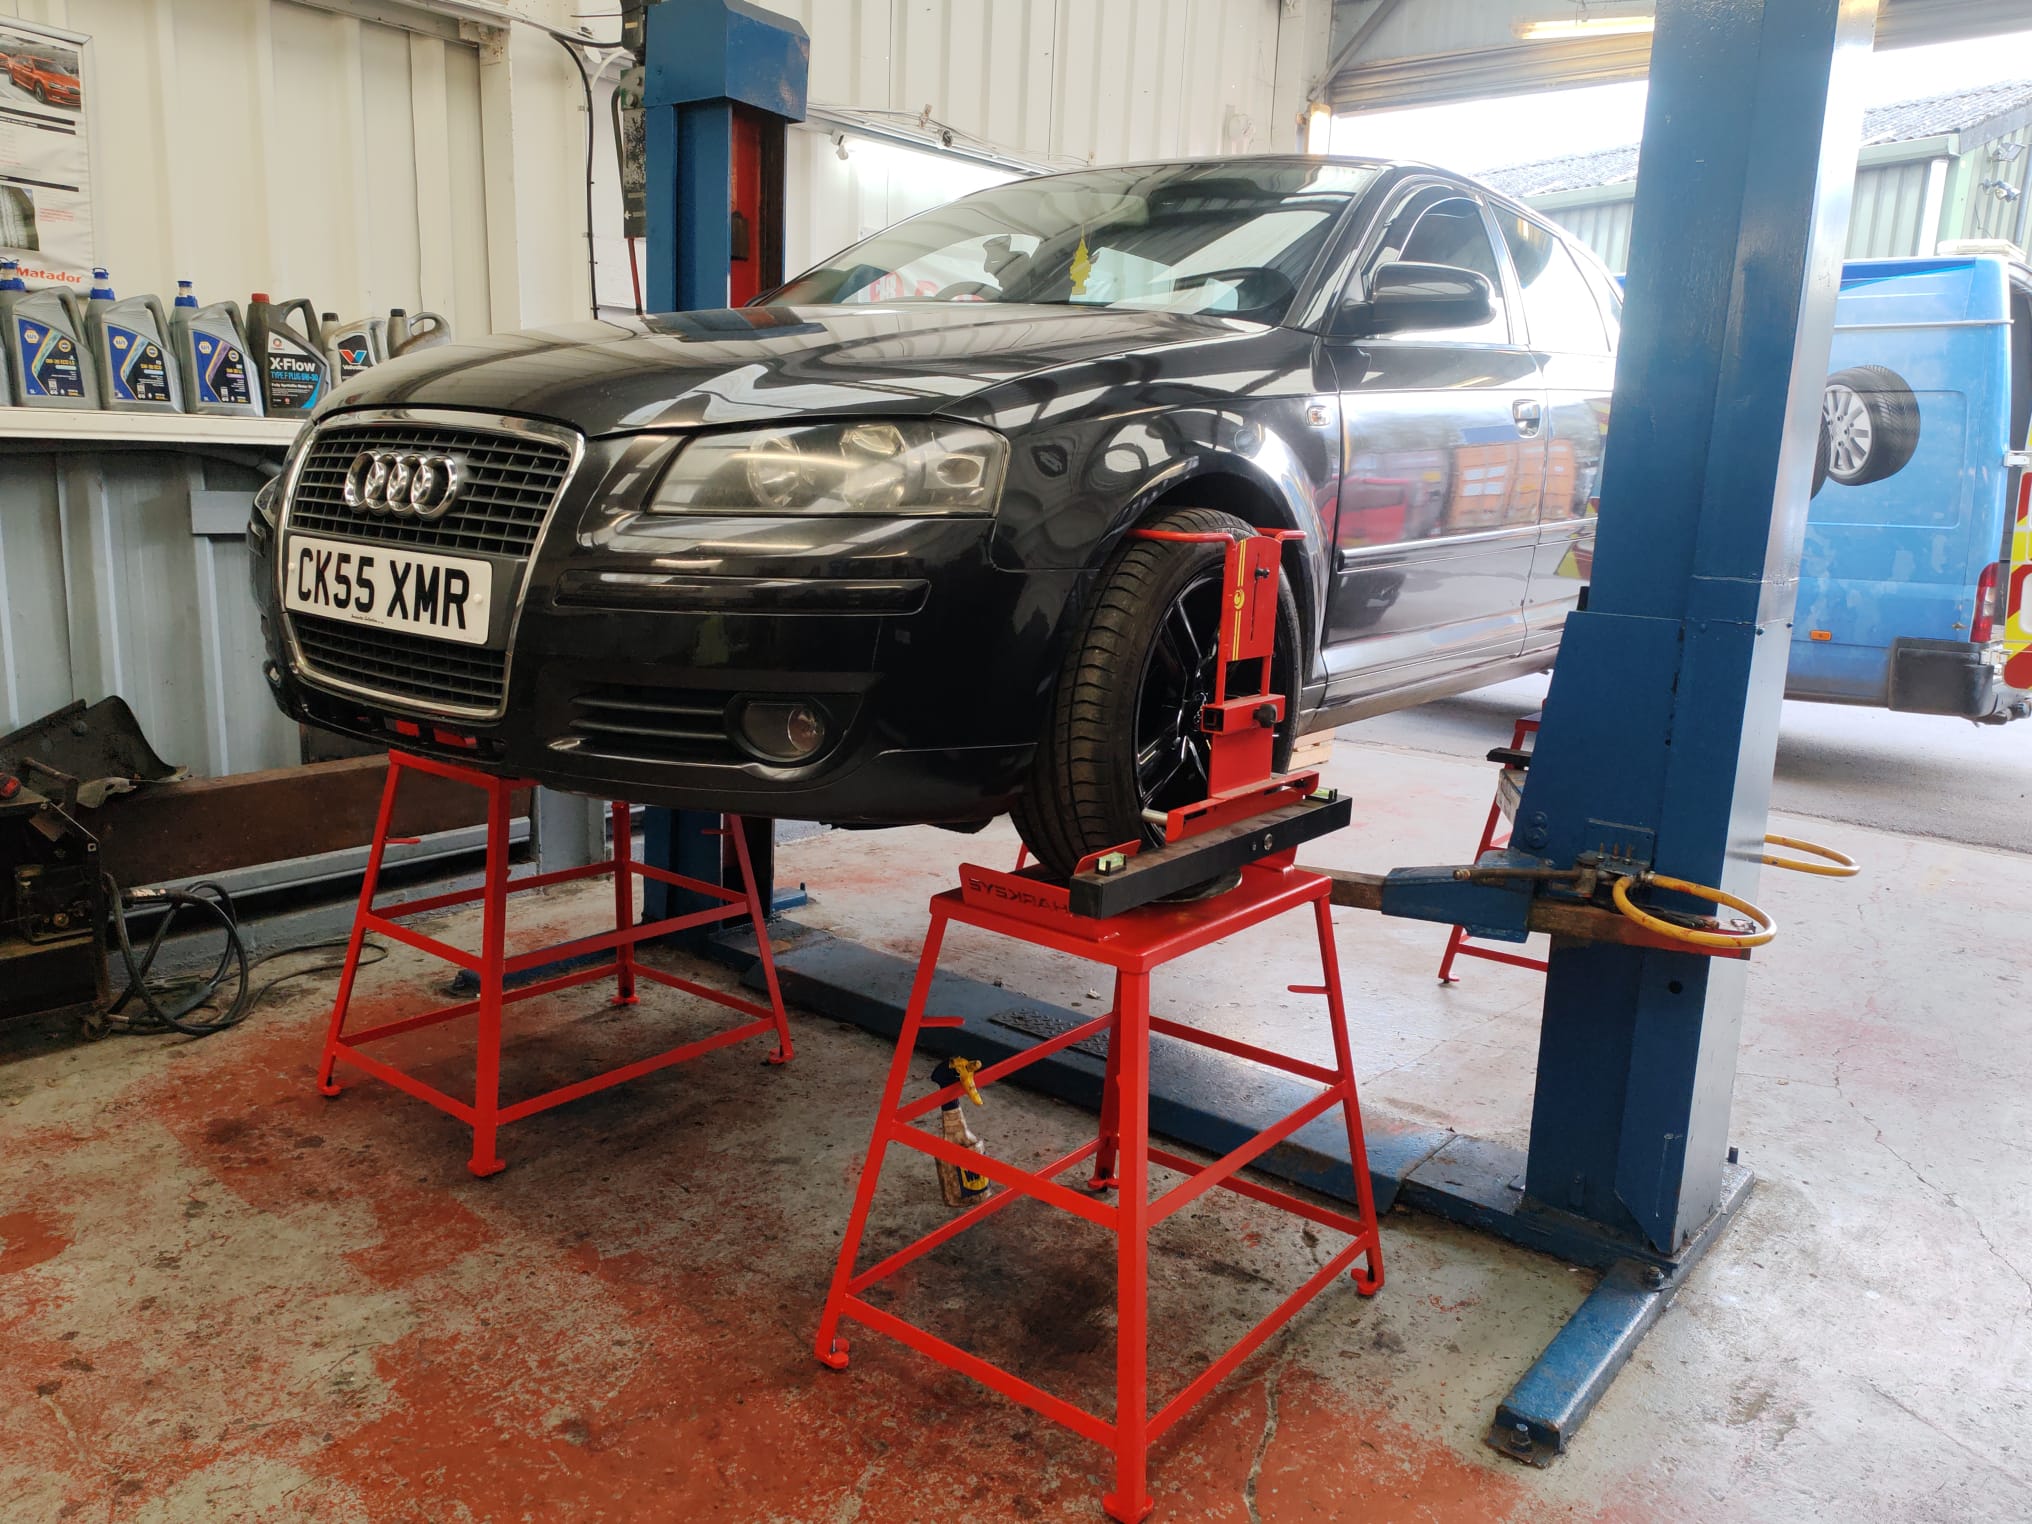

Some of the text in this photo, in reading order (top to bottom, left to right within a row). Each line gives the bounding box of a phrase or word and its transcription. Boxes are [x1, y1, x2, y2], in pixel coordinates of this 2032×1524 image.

[16, 267, 83, 284] Matador
[270, 357, 316, 372] X-Flow
[298, 548, 470, 630] CK55 XMR
